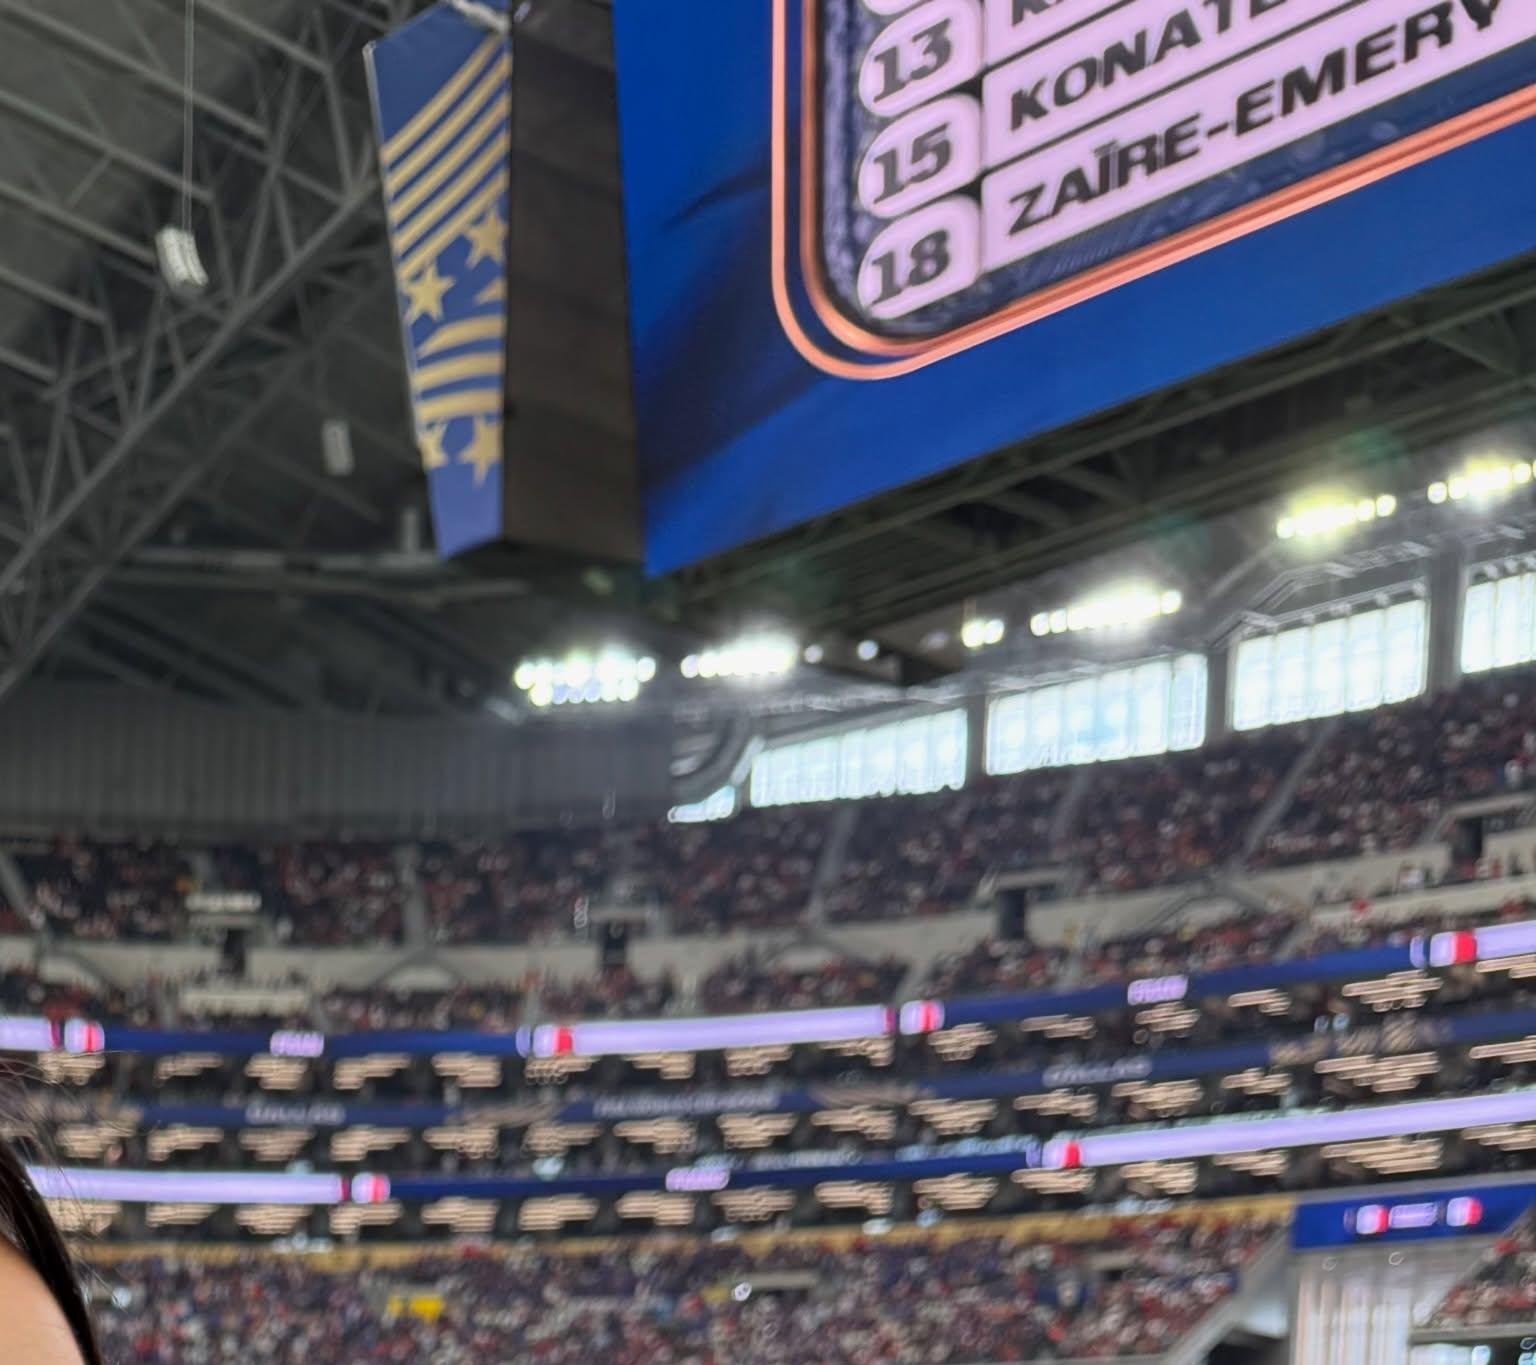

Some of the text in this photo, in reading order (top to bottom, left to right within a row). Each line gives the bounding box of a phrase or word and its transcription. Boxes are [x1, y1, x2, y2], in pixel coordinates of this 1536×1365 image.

[873, 18, 952, 101] 13
[873, 122, 952, 203] 15
[872, 229, 950, 302] 18
